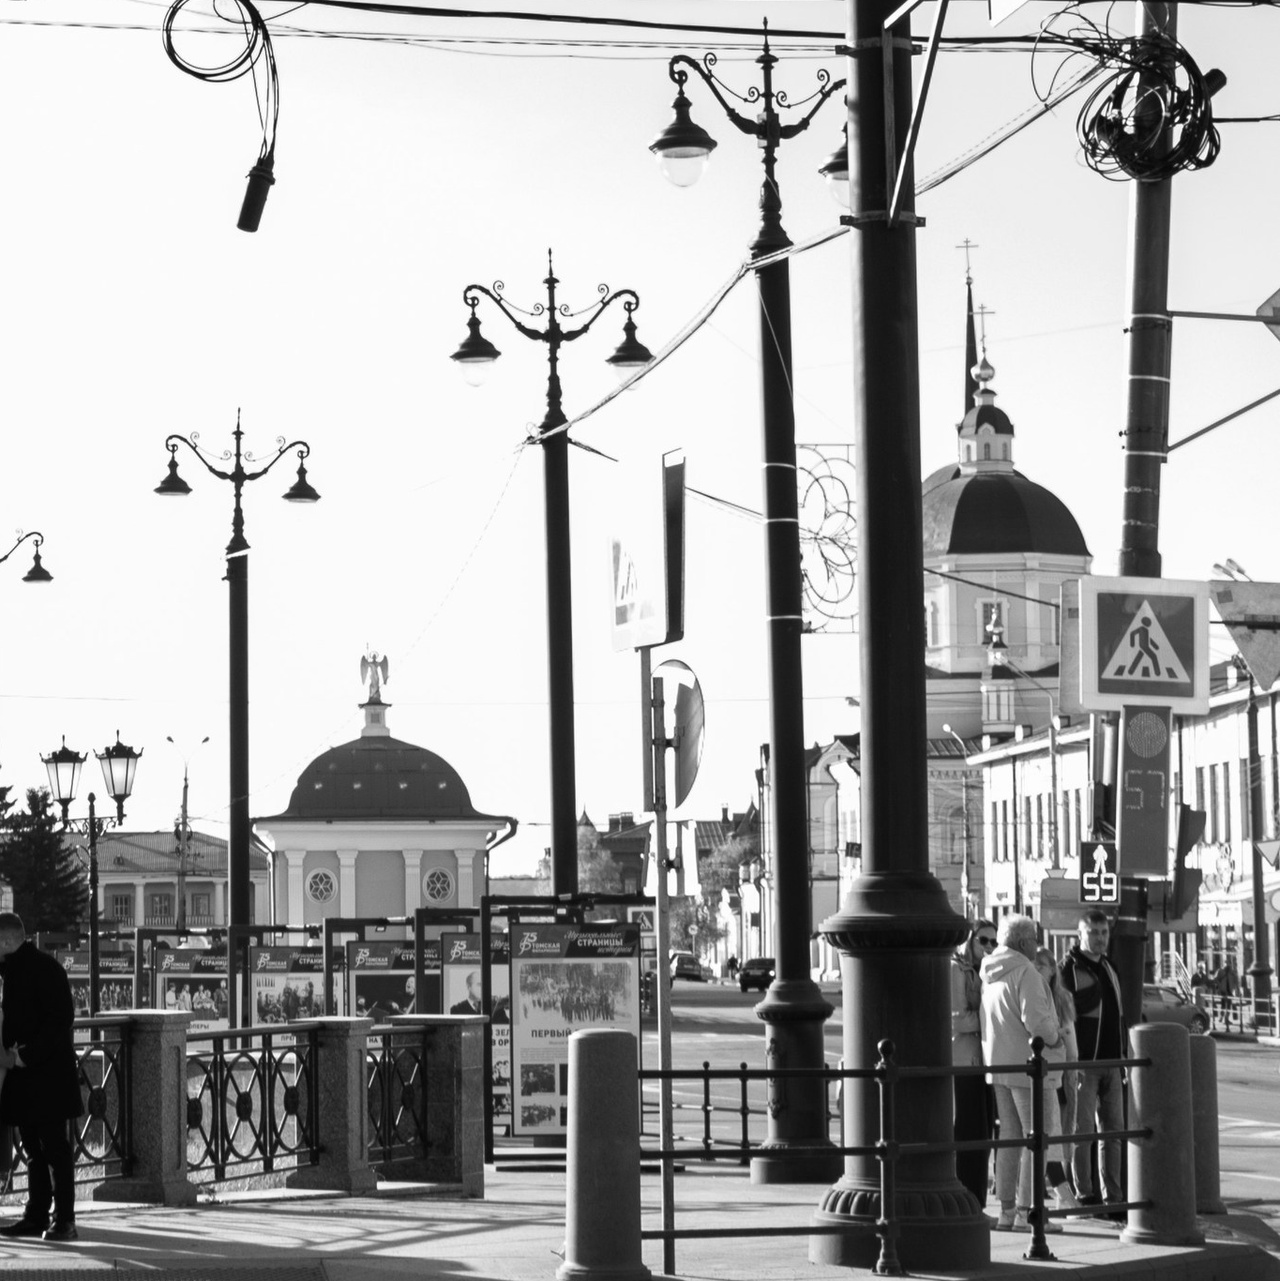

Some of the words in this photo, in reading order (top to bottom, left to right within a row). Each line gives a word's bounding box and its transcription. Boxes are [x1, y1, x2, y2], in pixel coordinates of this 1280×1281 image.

[1124, 769, 1165, 810] 57
[1082, 872, 1117, 902] 59
[577, 939, 623, 947] СТРАНИЦЫ
[531, 1027, 572, 1038] ПЕРВЫЙ
